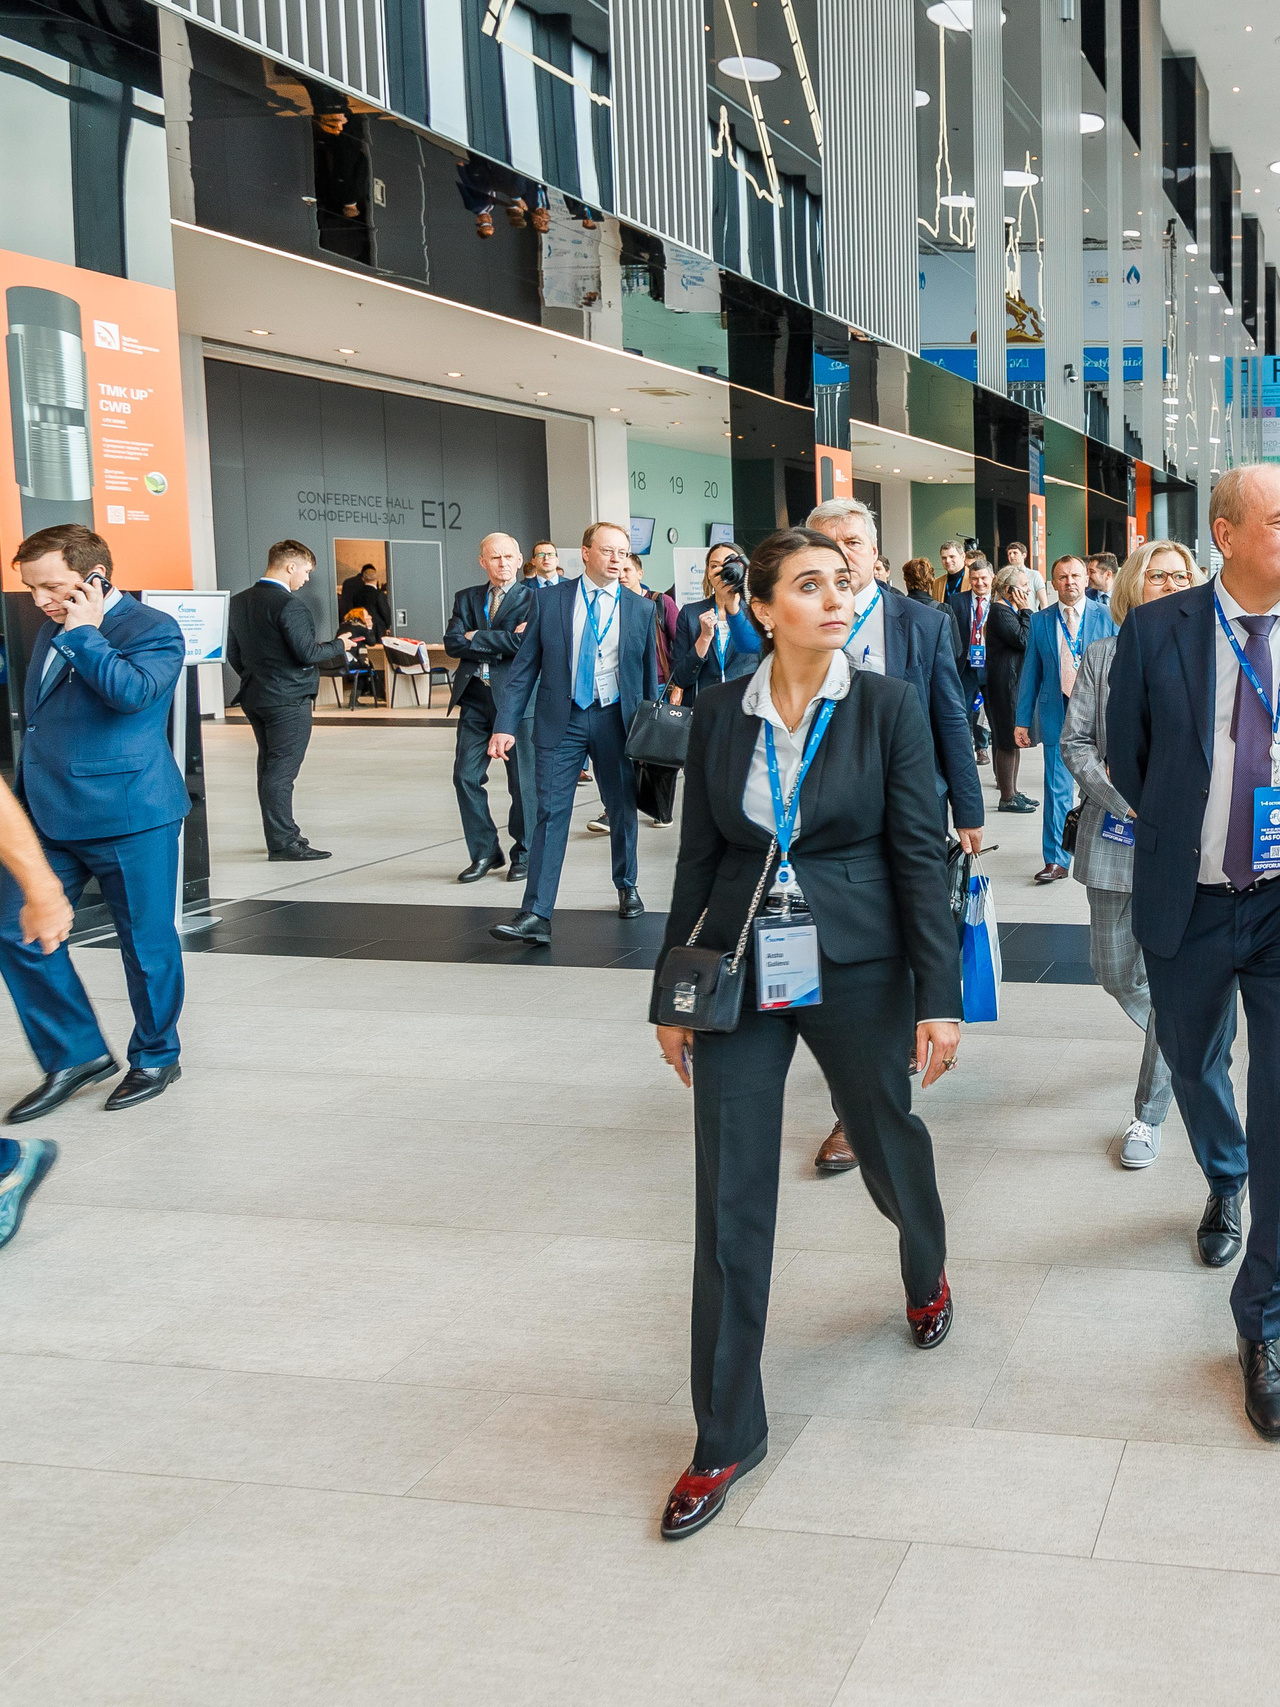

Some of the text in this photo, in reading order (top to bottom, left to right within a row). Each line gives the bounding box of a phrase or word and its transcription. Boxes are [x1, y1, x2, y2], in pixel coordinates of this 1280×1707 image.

[98, 383, 128, 399] TMK
[99, 400, 131, 414] CWB
[631, 471, 646, 490] 18
[669, 476, 684, 494] 19
[704, 481, 718, 498] 20
[297, 491, 414, 510] CONFERENCE HALL
[298, 509, 405, 526] КОНФЕРЕНЦ-ЗАЛ
[422, 500, 462, 530] E12
